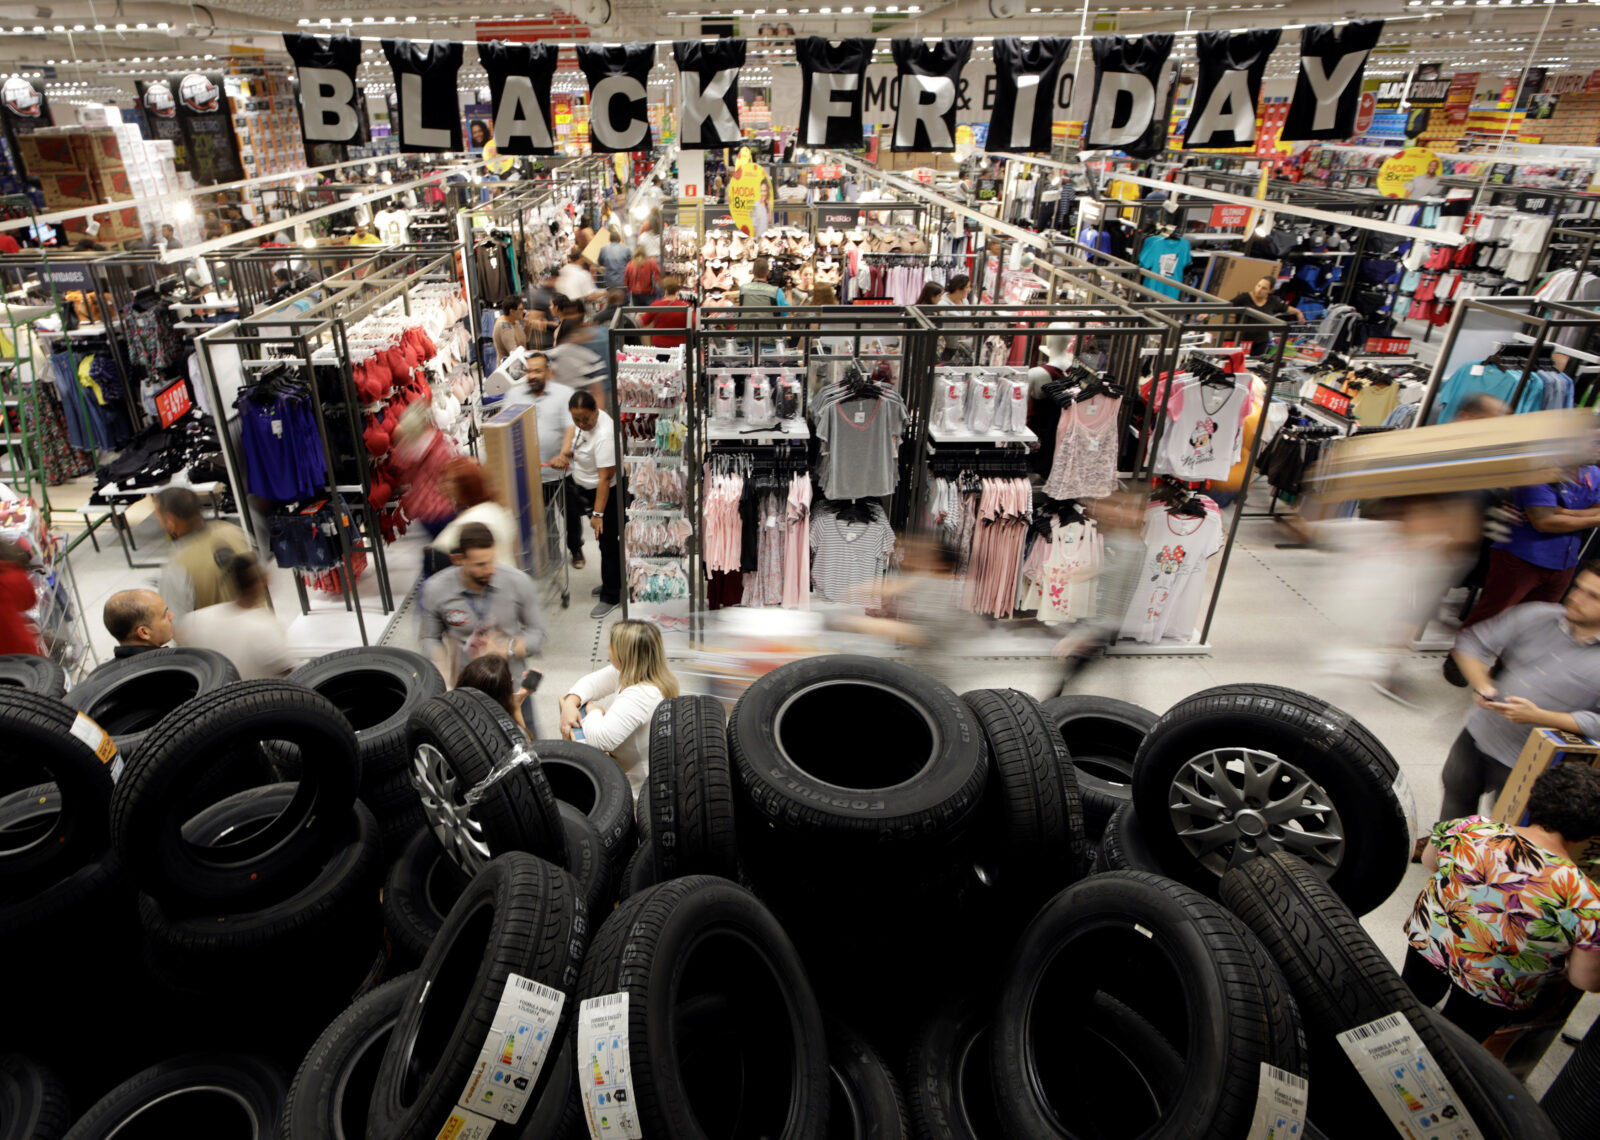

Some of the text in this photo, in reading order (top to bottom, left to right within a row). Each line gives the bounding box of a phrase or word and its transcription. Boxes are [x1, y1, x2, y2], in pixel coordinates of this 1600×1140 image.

[298, 67, 742, 149] BLACK
[806, 49, 1372, 148] FRIDAY
[1411, 81, 1451, 99] FRIDAY
[731, 186, 755, 197] MODA
[734, 196, 746, 209] 8x
[769, 768, 886, 811] FORMULA
[464, 1061, 487, 1104] FORMULA
